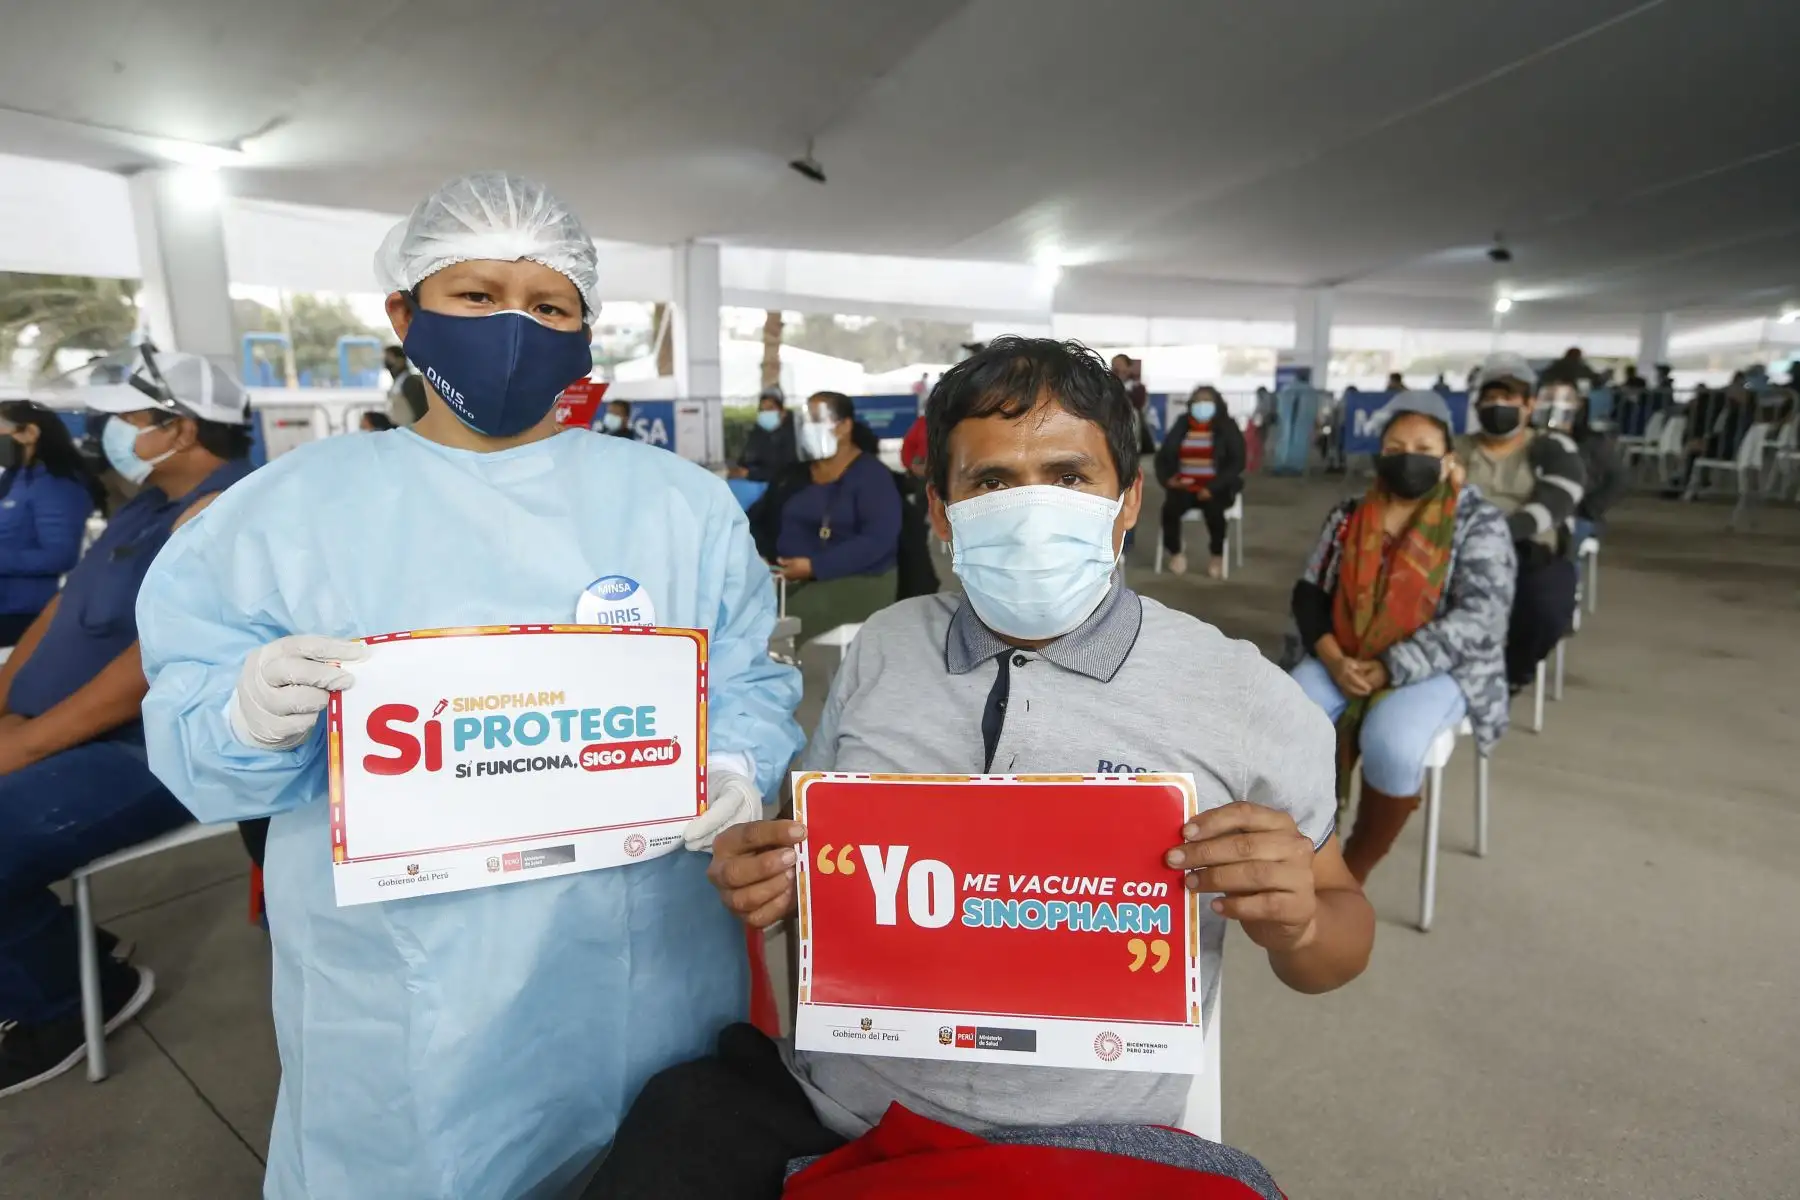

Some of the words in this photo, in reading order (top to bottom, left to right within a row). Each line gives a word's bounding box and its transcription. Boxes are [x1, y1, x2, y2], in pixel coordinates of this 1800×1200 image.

[426, 366, 465, 405] DIRIS
[598, 583, 632, 594] MINSA
[597, 607, 641, 624] DIRIS
[453, 691, 566, 712] SINOPHARM
[453, 705, 657, 752] PROTEGE
[476, 754, 579, 777] FUNCIONA,
[583, 749, 627, 767] SIGO
[378, 877, 416, 887] Gobierno
[417, 874, 430, 882] del
[431, 871, 449, 881] Perú
[961, 873, 1001, 892] ME
[1007, 875, 1117, 897] VACUNE
[1121, 880, 1168, 897] con
[960, 897, 1171, 934] SINOPHARM
[832, 1029, 867, 1039] Gobierno
[868, 1032, 880, 1040] del
[882, 1033, 899, 1041] Perú
[957, 1033, 974, 1041] PERÚ
[978, 1034, 1003, 1042] Ministerio
